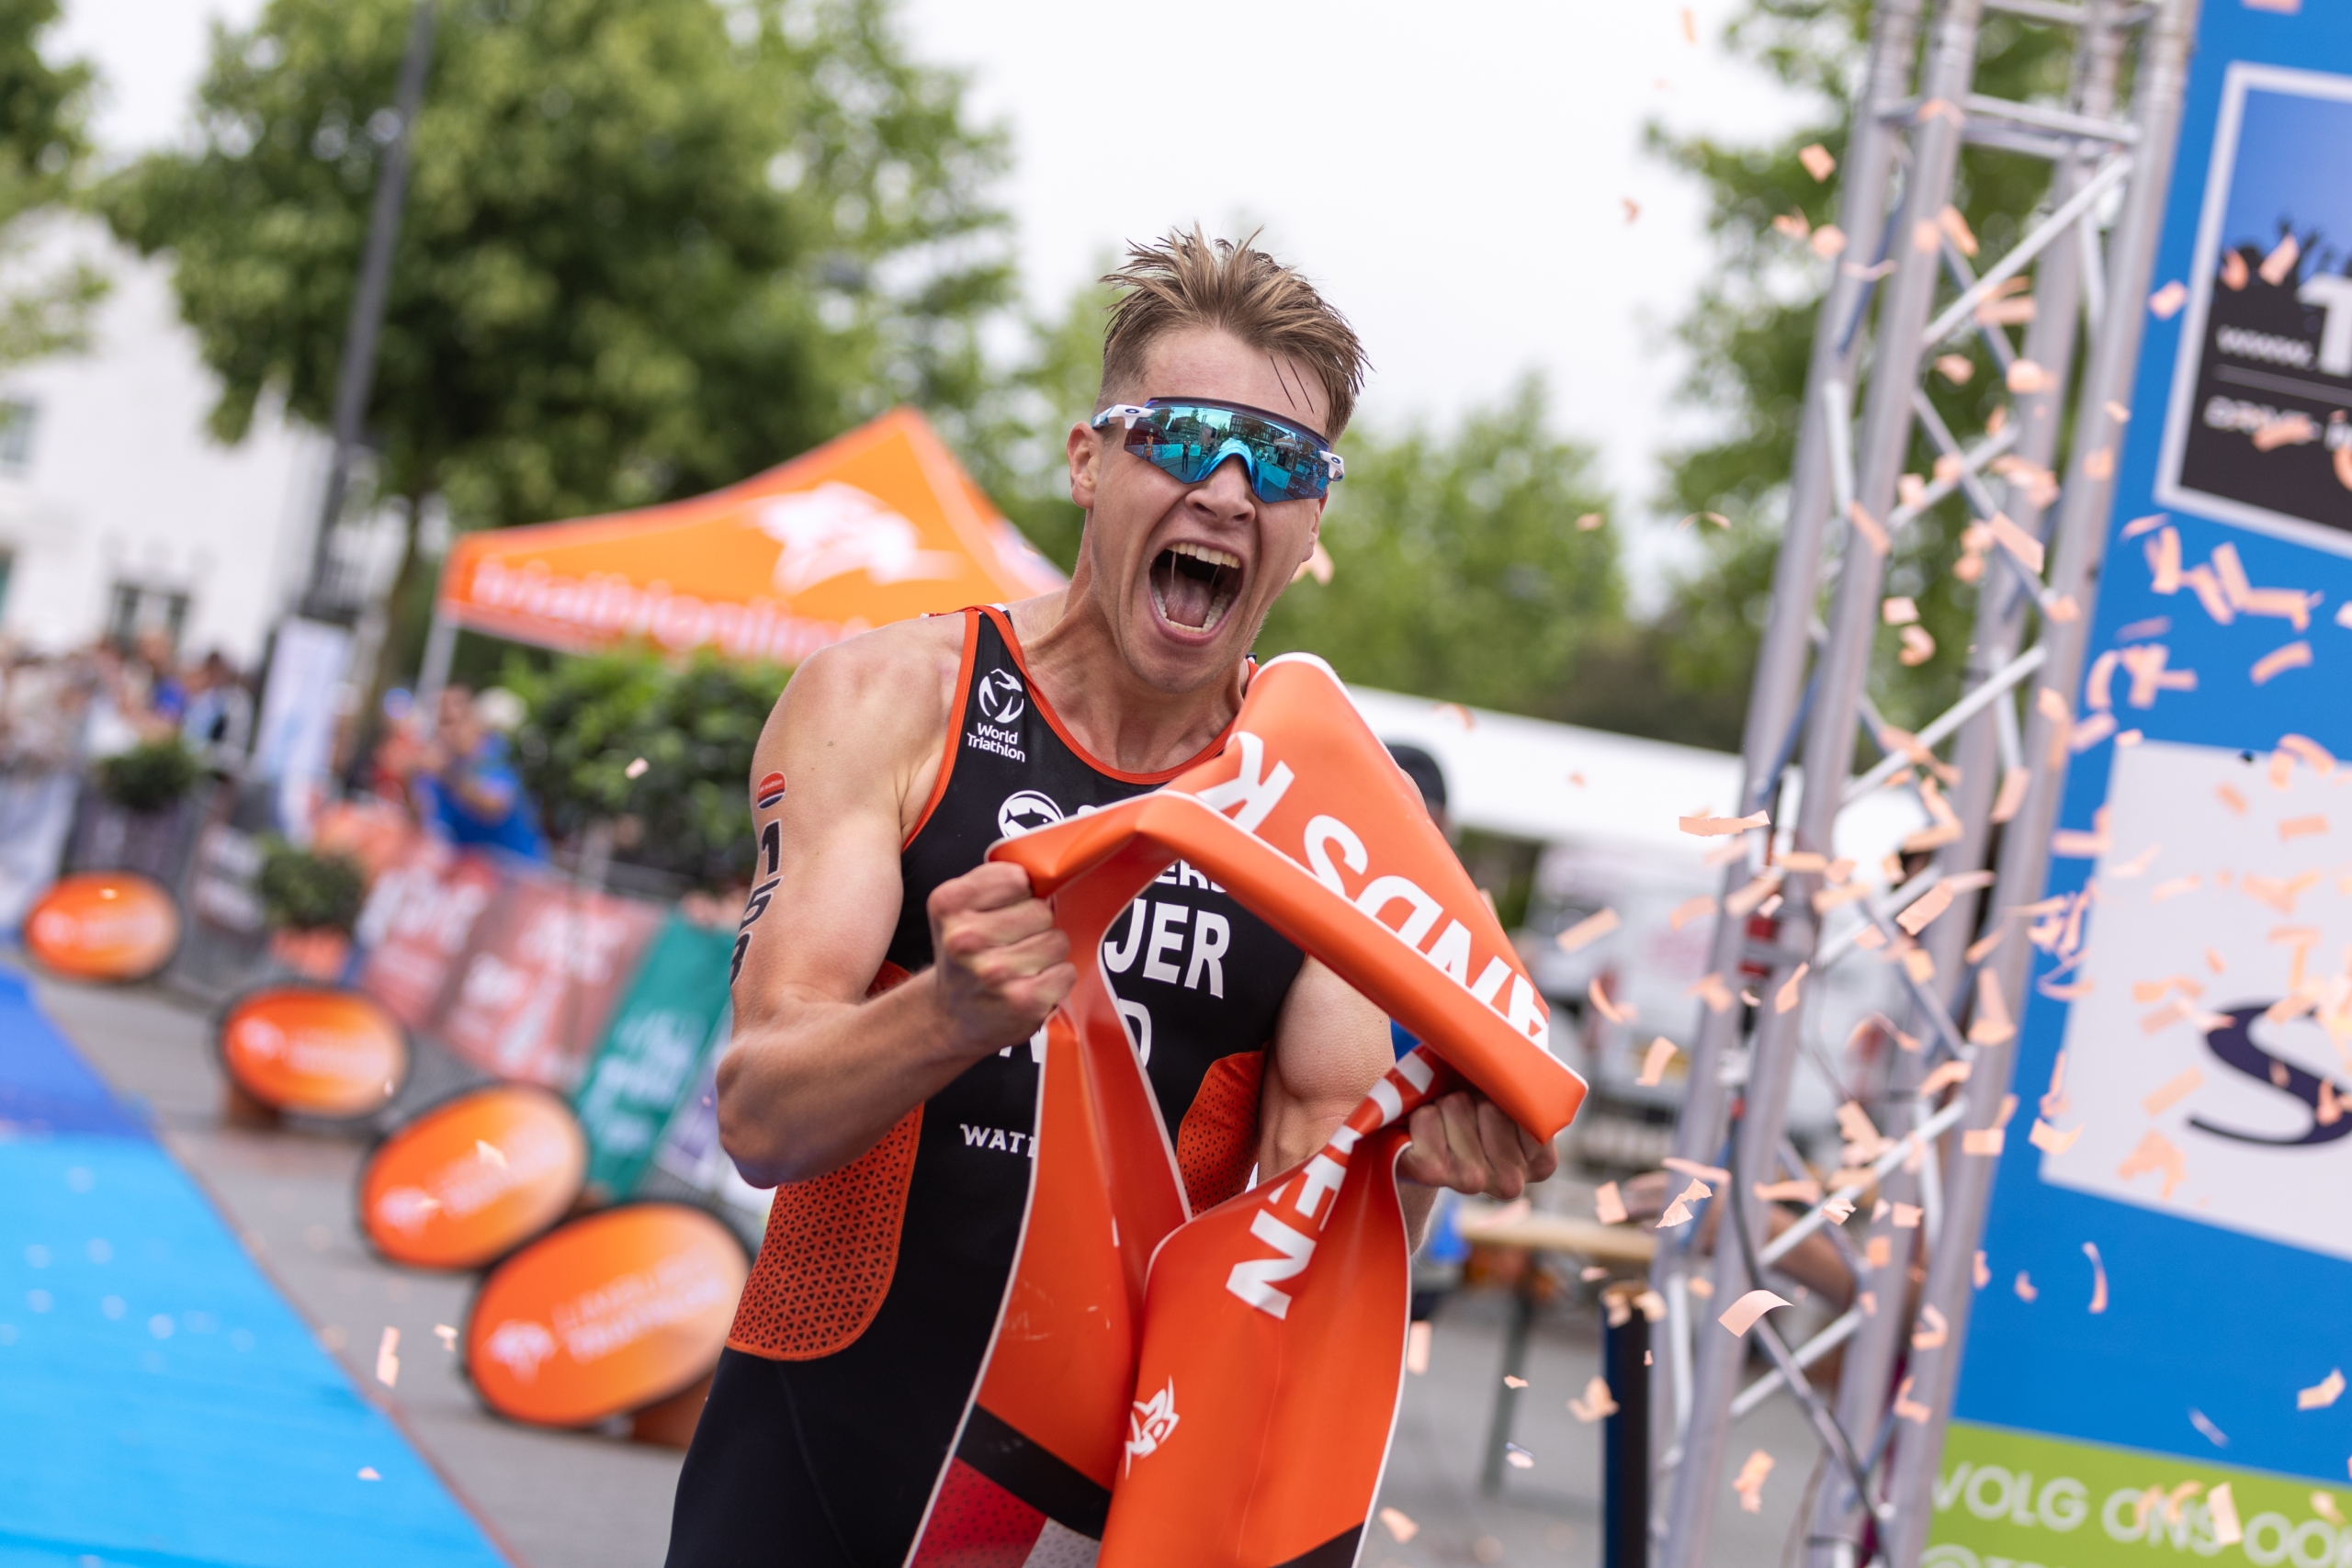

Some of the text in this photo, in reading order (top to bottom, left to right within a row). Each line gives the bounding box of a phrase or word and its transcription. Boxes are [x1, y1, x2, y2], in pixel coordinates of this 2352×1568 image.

[967, 732, 1026, 762] Triathlon
[977, 722, 1018, 745] World
[1104, 897, 1230, 999] JER
[1932, 1461, 2089, 1532] VOLG
[2243, 1511, 2352, 1567] OO
